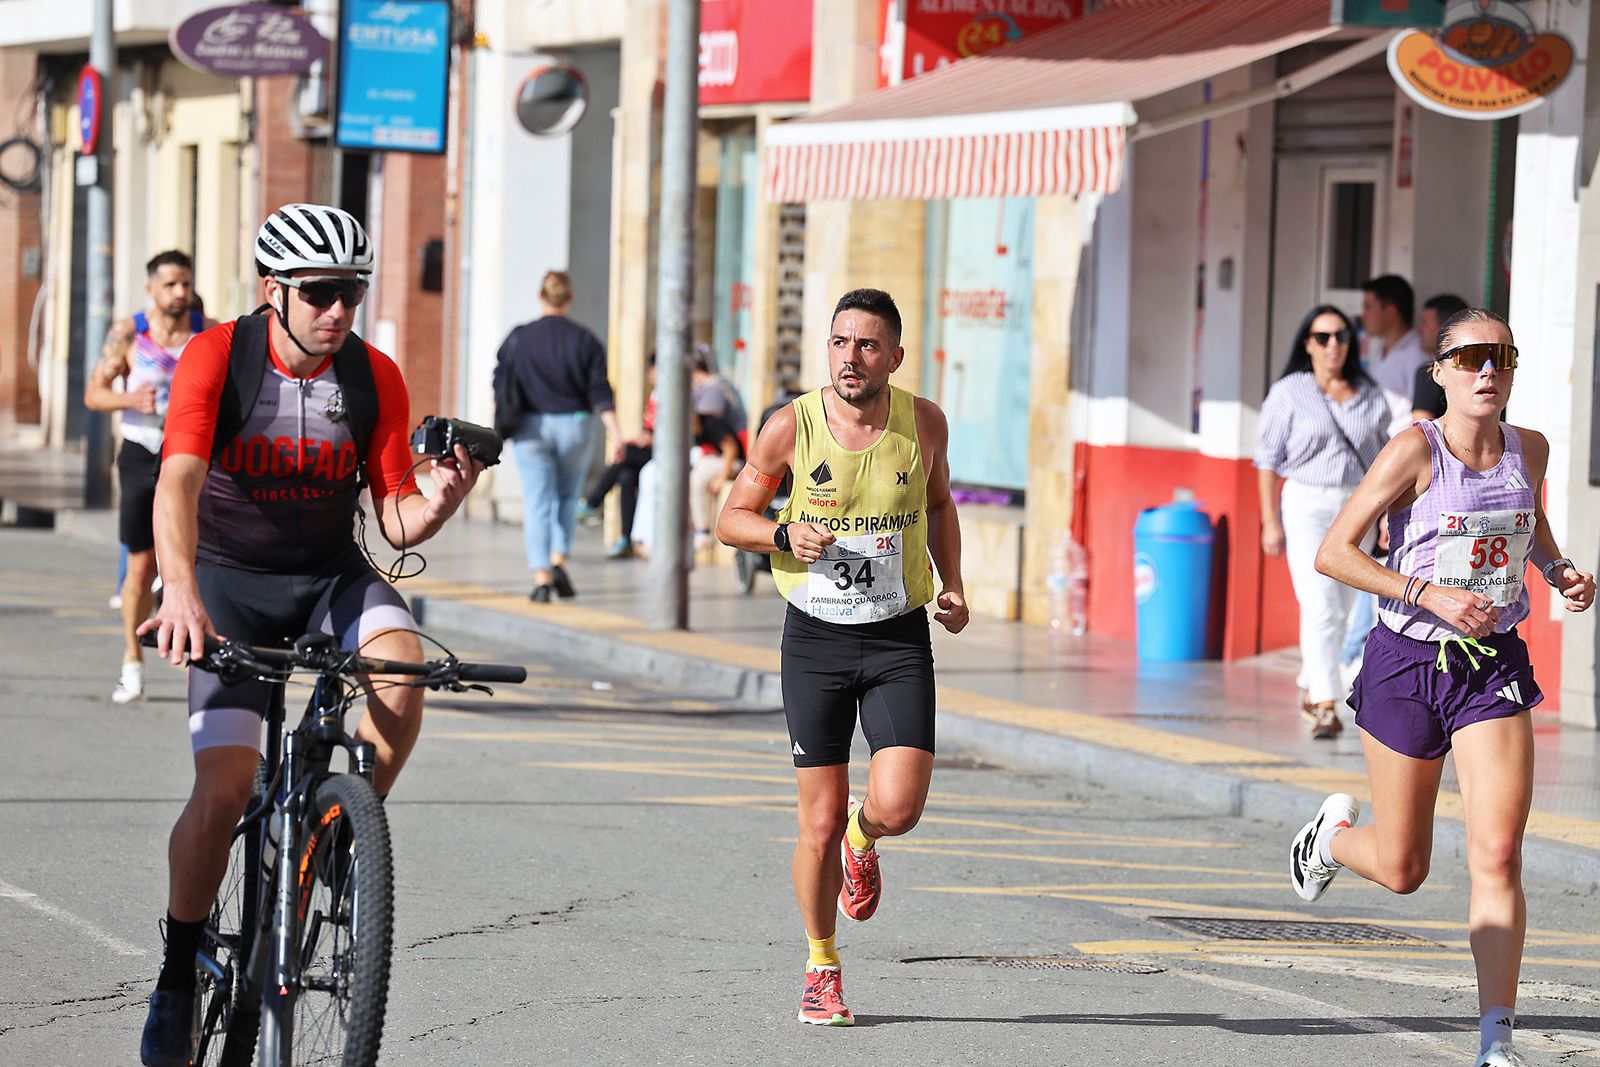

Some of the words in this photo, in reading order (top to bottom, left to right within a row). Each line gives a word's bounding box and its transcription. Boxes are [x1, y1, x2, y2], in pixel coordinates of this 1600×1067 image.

[265, 235, 286, 254] LAZER
[808, 497, 837, 508] valora
[799, 510, 851, 532] AMIGOS
[854, 509, 919, 532] PIRÁMIDE
[1469, 536, 1509, 570] 58
[833, 560, 876, 591] 34
[1440, 577, 1487, 587] HERRERO
[810, 597, 853, 605] ZAMBRANO
[854, 592, 898, 605] CUADRADO
[812, 605, 853, 616] Huelva
